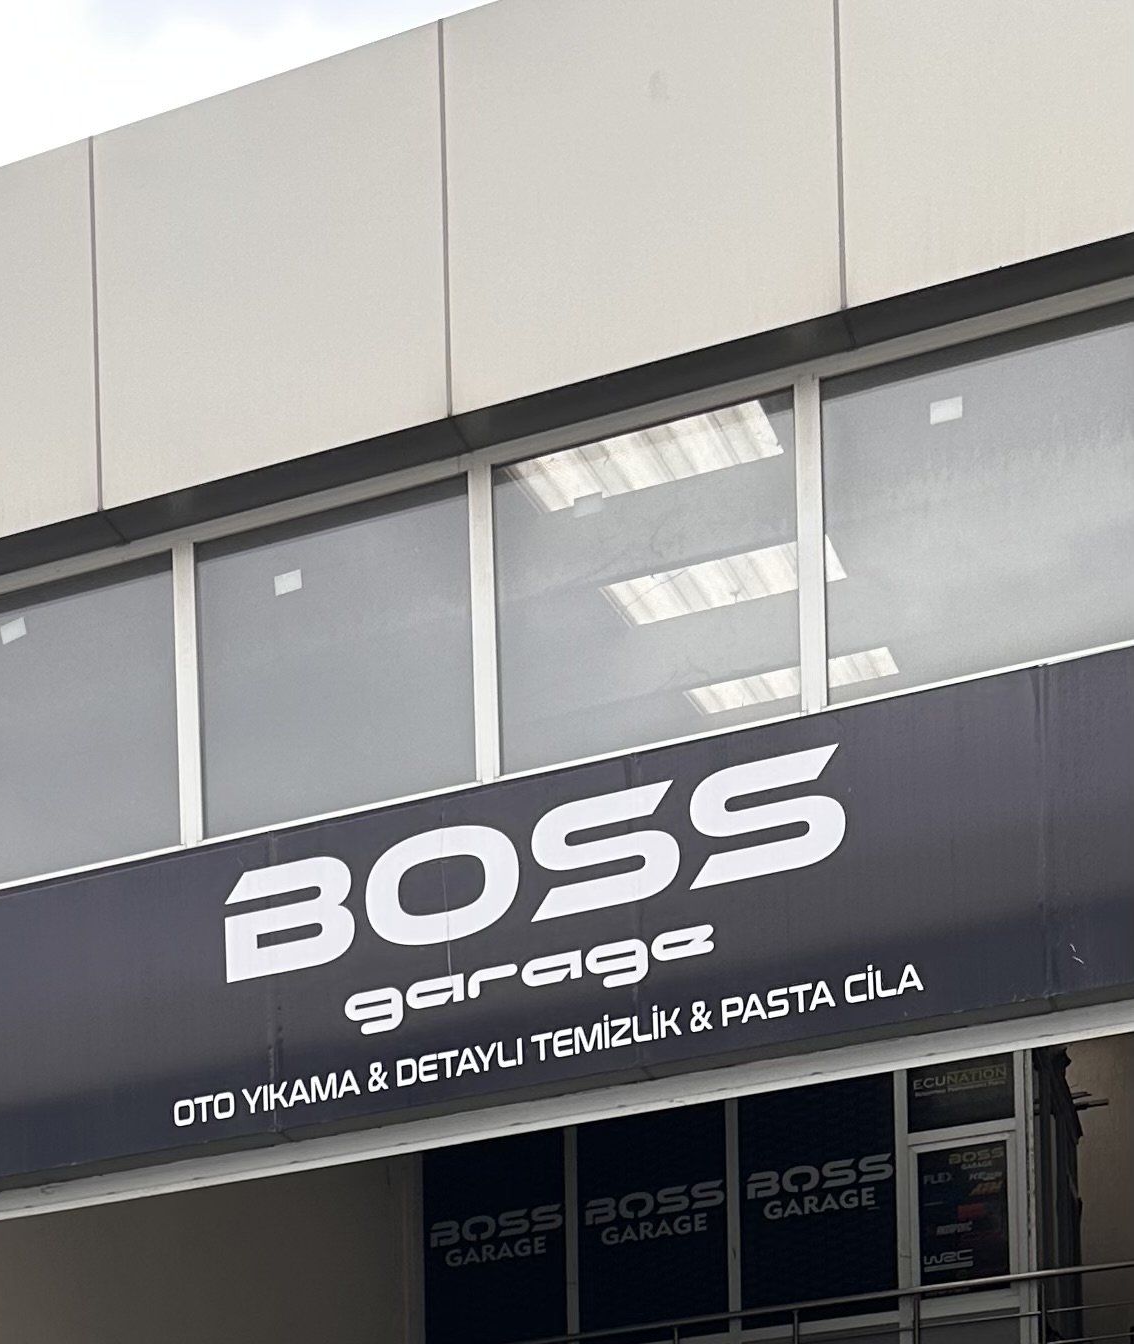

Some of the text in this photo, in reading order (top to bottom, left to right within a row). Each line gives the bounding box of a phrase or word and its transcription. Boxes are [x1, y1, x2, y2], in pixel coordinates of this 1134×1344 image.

[224, 743, 847, 983] BOSS
[344, 923, 715, 1035] garage
[172, 963, 925, 1127] OTO YIKAMA & DETAYLI TEMİZLİK & PASTA CİLA
[745, 1152, 895, 1201] BOSS
[429, 1203, 564, 1248] BOSS
[584, 1179, 726, 1226] BOSS
[763, 1186, 875, 1221] GARAGE
[444, 1236, 547, 1269] GARAGE
[600, 1212, 708, 1246] GARAGE
